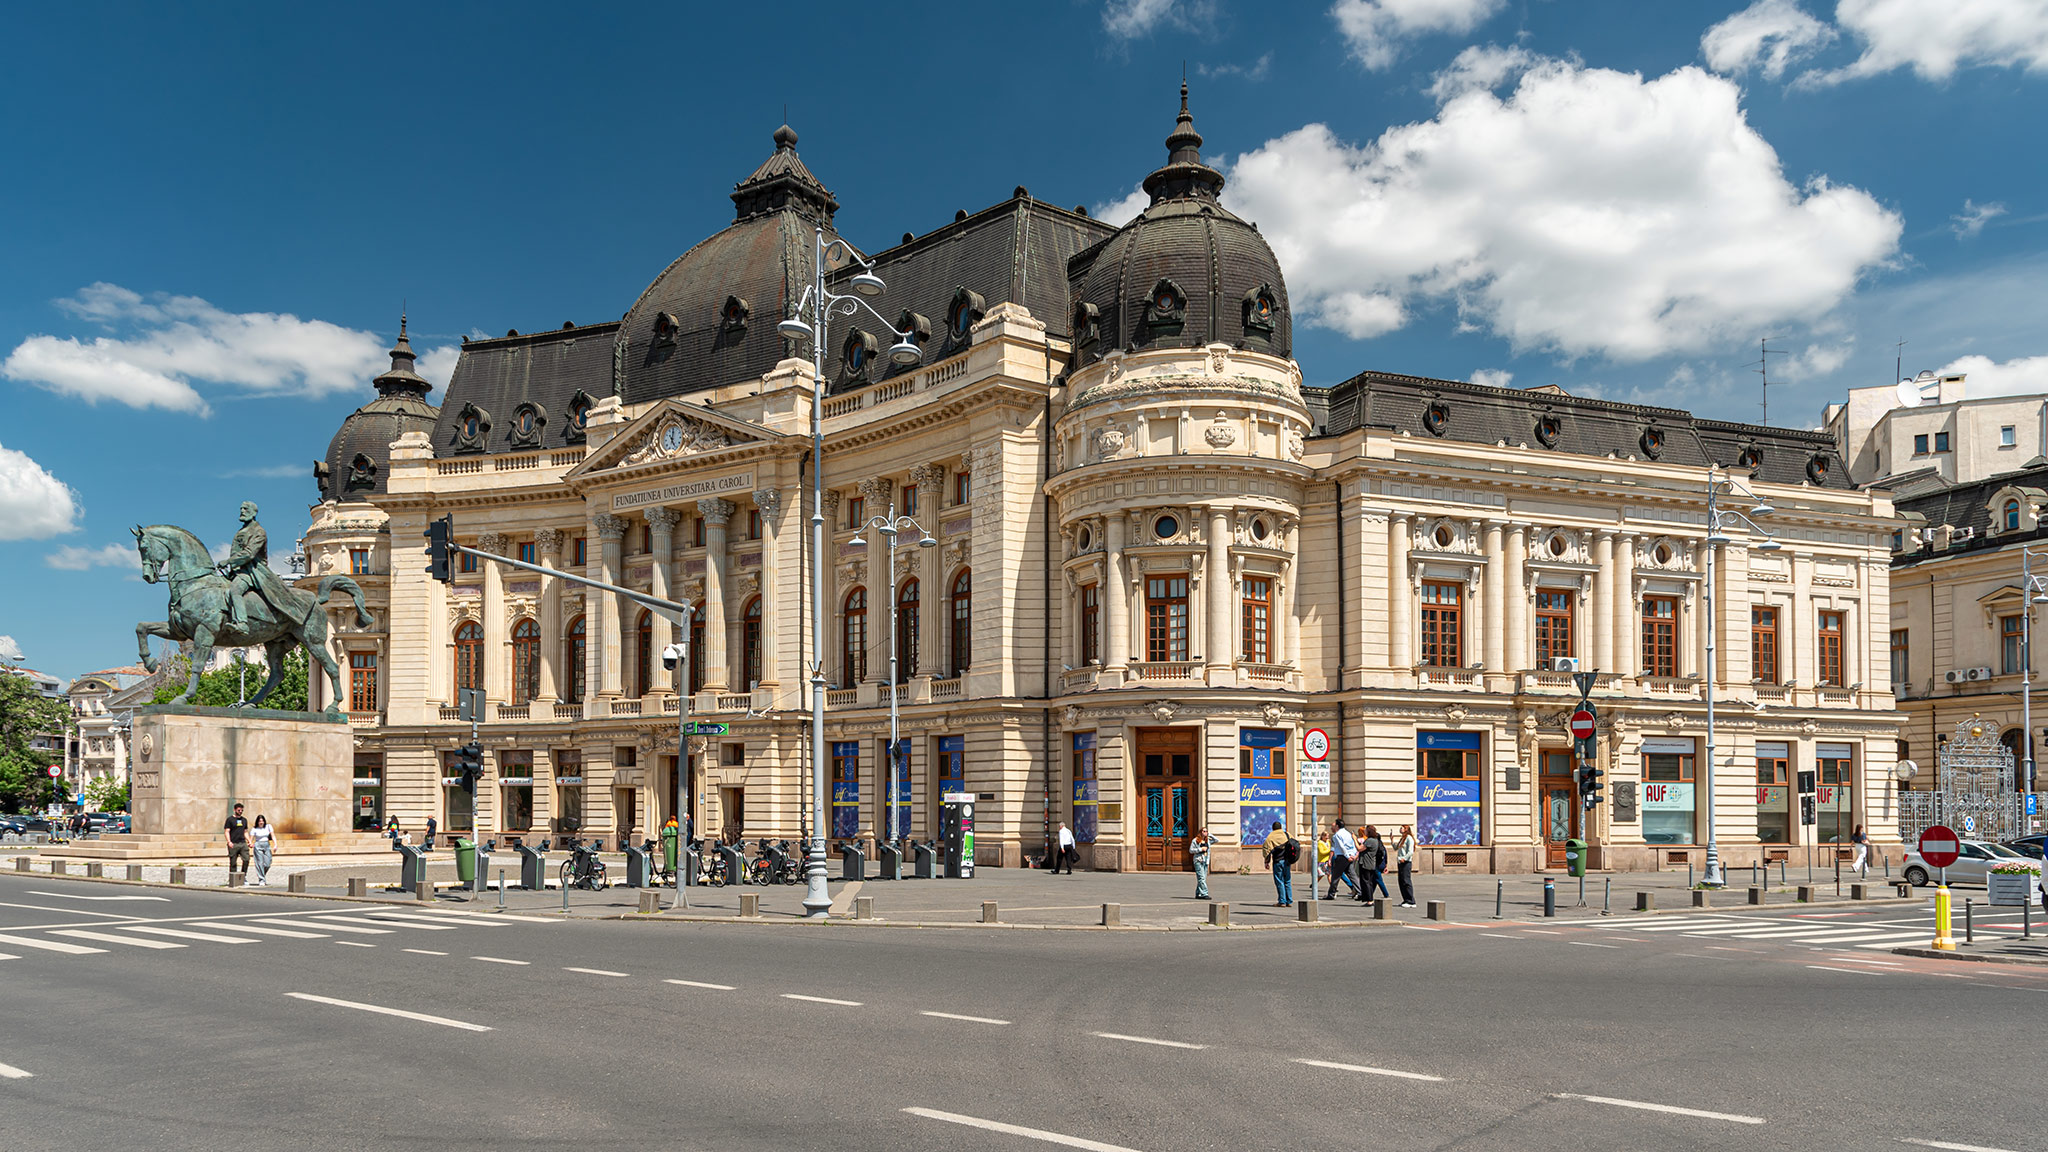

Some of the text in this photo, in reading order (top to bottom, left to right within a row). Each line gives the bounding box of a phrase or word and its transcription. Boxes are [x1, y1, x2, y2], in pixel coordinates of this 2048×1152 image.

[719, 477, 744, 489] CAROL
[746, 475, 750, 485] I
[1646, 785, 1667, 802] AUF
[1756, 787, 1768, 804] UF
